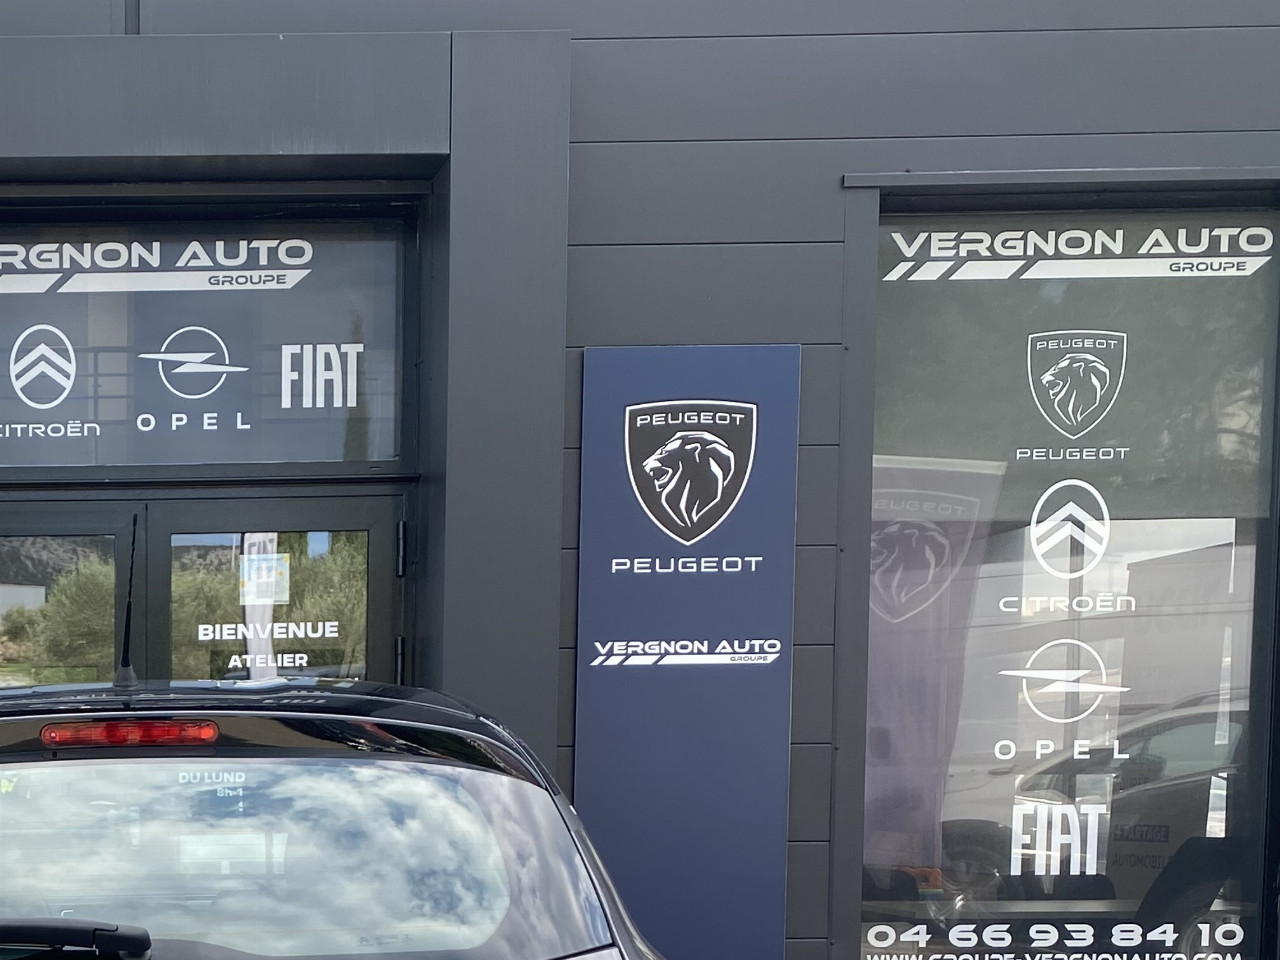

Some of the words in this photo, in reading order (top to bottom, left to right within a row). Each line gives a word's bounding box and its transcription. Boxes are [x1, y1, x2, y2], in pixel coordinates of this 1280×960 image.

[891, 229, 1124, 257] VERGNON
[1137, 226, 1274, 254] AUTO
[175, 239, 314, 267] AUTO
[1169, 261, 1247, 272] GROUPE
[208, 274, 288, 286] GROUPE
[1036, 338, 1118, 350] PEUGEOT
[281, 343, 363, 408] FIAT
[136, 411, 251, 431] OPEL
[637, 412, 745, 427] PEUGEOT
[1016, 447, 1130, 460] PEUGEOT
[873, 499, 967, 516] EUGEOT
[611, 556, 763, 573] PEUGEOT
[999, 593, 1135, 612] CITROËN
[198, 621, 339, 641] BIENVENUE
[594, 640, 708, 655] VERGNON
[714, 639, 781, 653] AUTO
[227, 653, 308, 669] ATELIER
[993, 739, 1130, 760] OPEL
[178, 772, 200, 784] DU
[204, 771, 246, 783] LUND
[1010, 804, 1106, 876] FIAT
[867, 923, 932, 948] 04
[948, 923, 1012, 948] 66
[1028, 923, 1094, 948] 93
[1111, 923, 1179, 947] 84
[1197, 922, 1245, 947] 10
